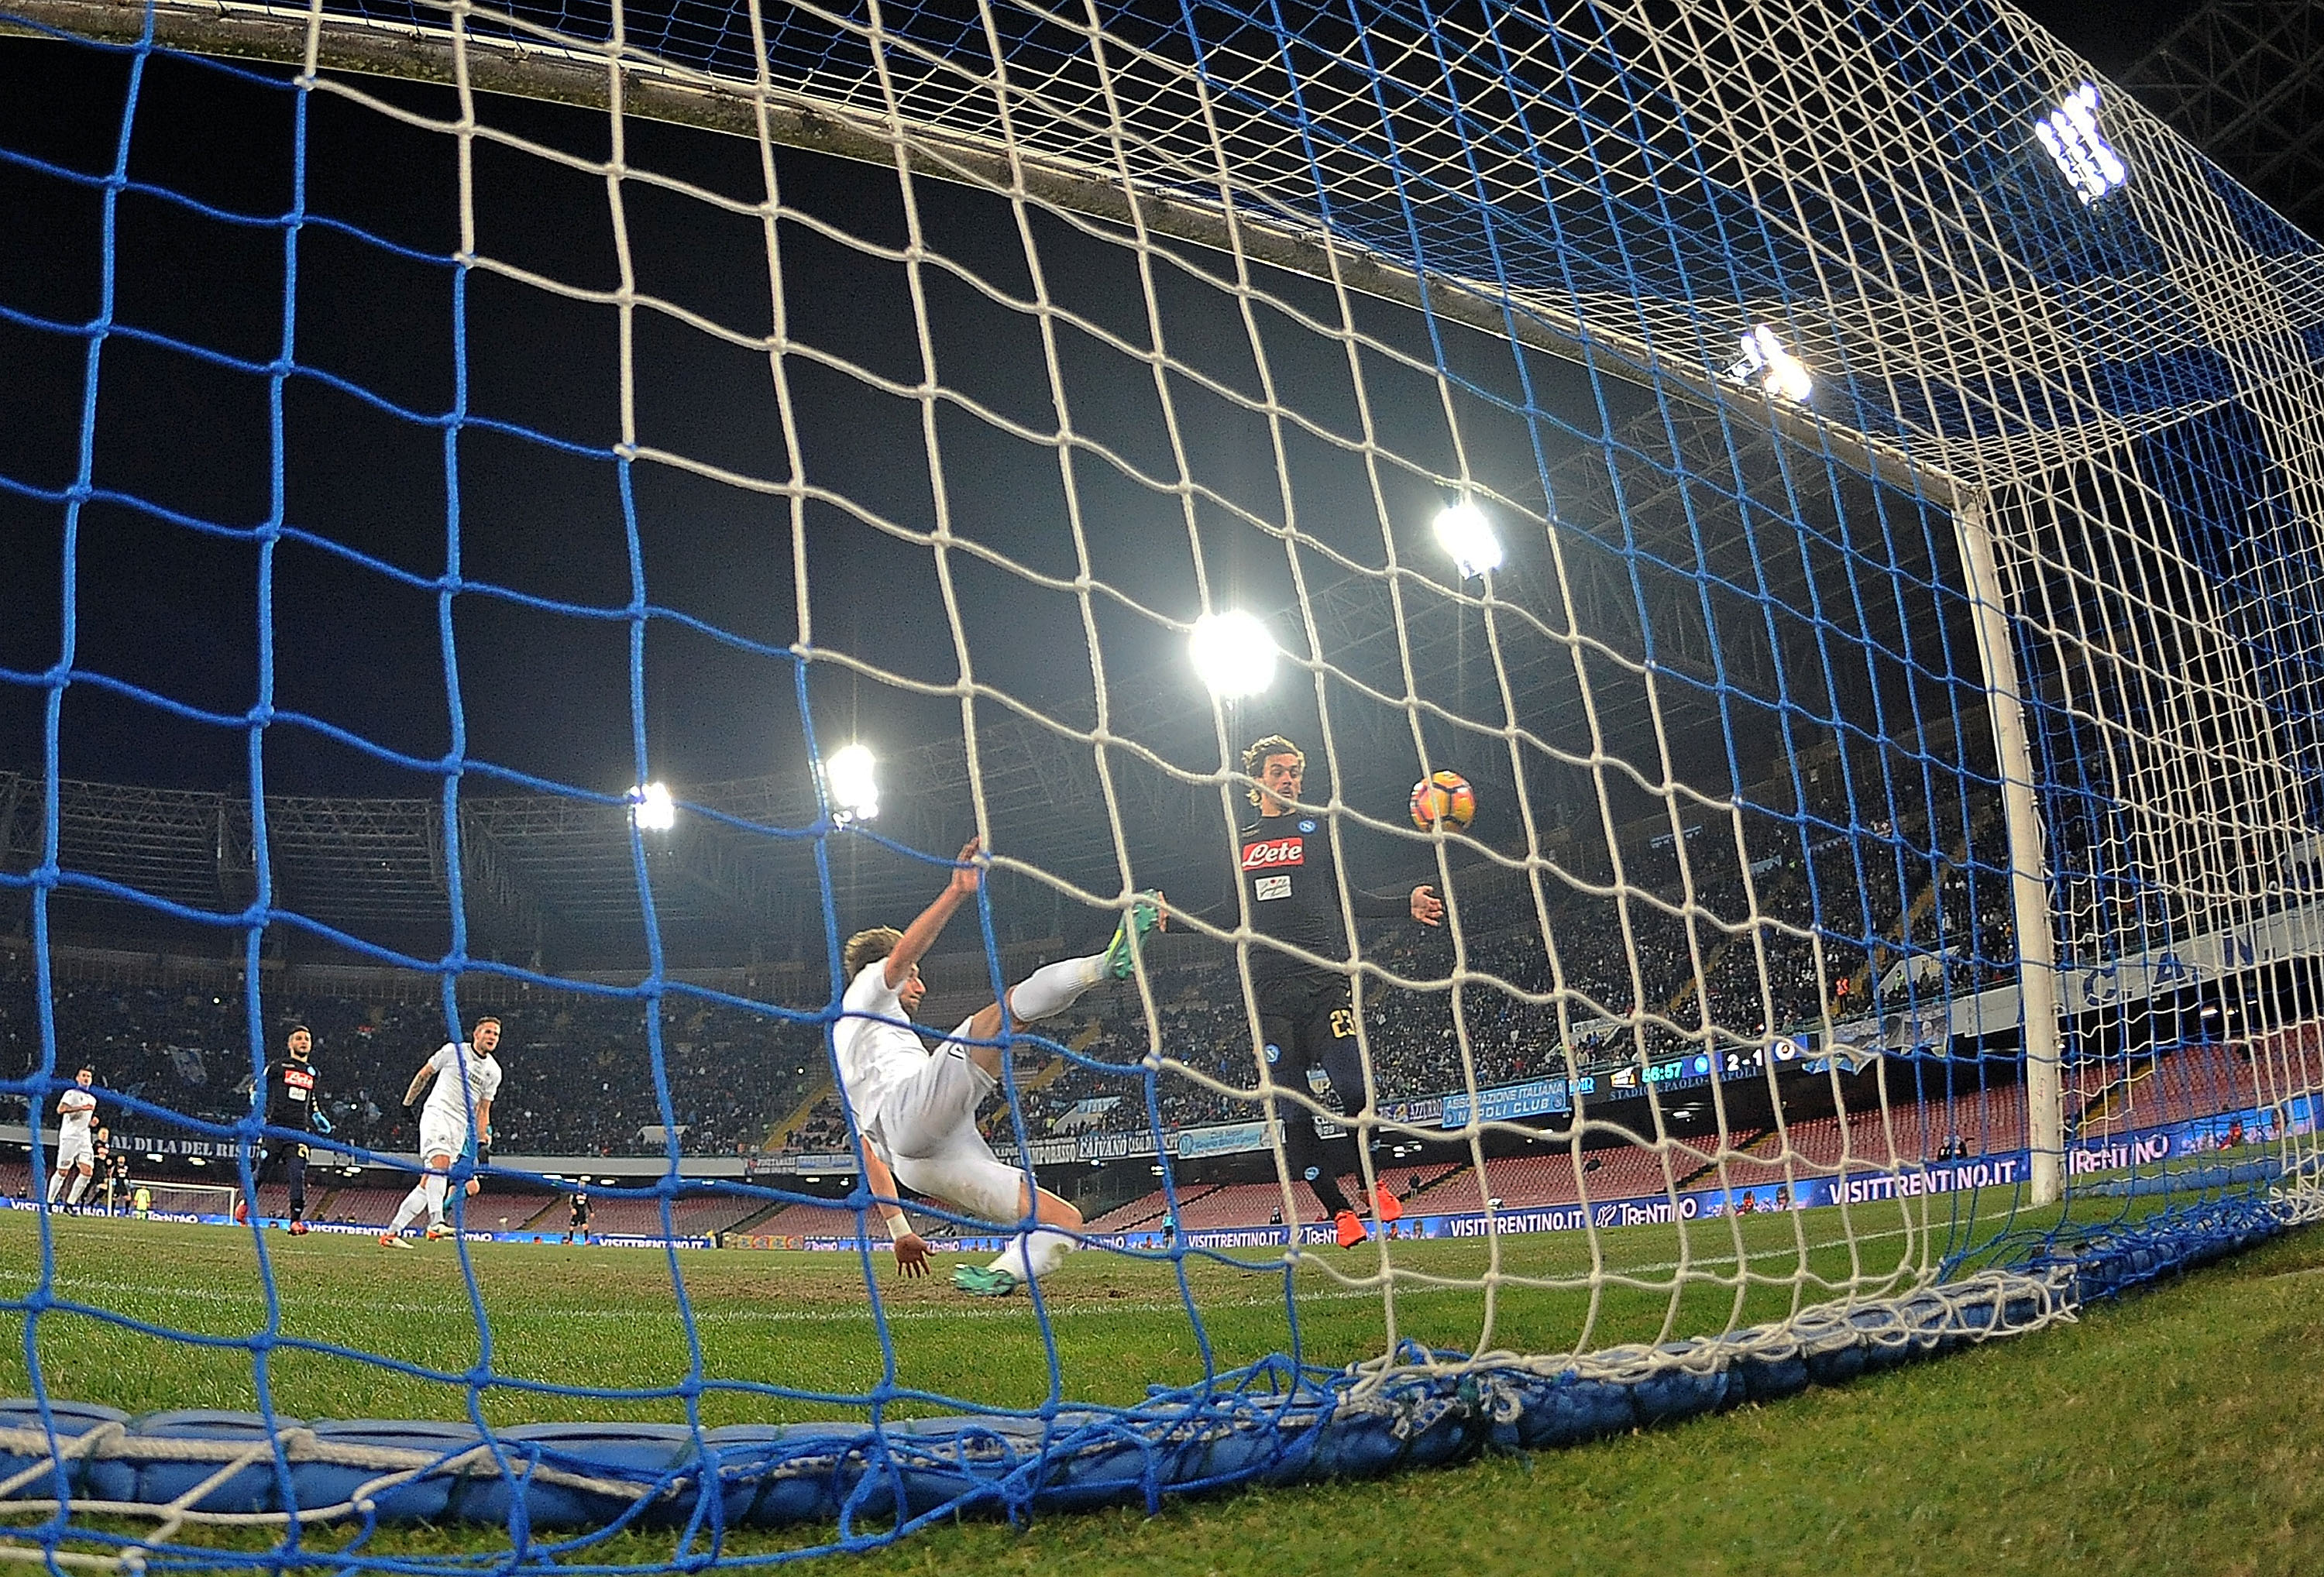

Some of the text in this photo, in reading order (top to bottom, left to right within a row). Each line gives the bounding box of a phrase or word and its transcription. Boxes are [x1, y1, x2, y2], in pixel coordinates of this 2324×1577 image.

[1242, 842, 1302, 867] Lete
[1446, 1082, 1563, 1109] ASSOIAZIONE ITALIANA
[1410, 1098, 1442, 1120] AZZURRO
[1458, 1098, 1549, 1122] NPOLI CLUB
[111, 1136, 131, 1150] AL
[135, 1137, 153, 1152] DI
[156, 1139, 177, 1154] LA
[181, 1141, 212, 1156] DEL
[1079, 1138, 1126, 1159] CAIVANO
[1829, 1160, 2016, 1204] VISITTRENTINO.IT
[1618, 1197, 1697, 1226] TRENTINO
[1188, 1227, 1339, 1248] VISITTRENTINO.IT TRENT
